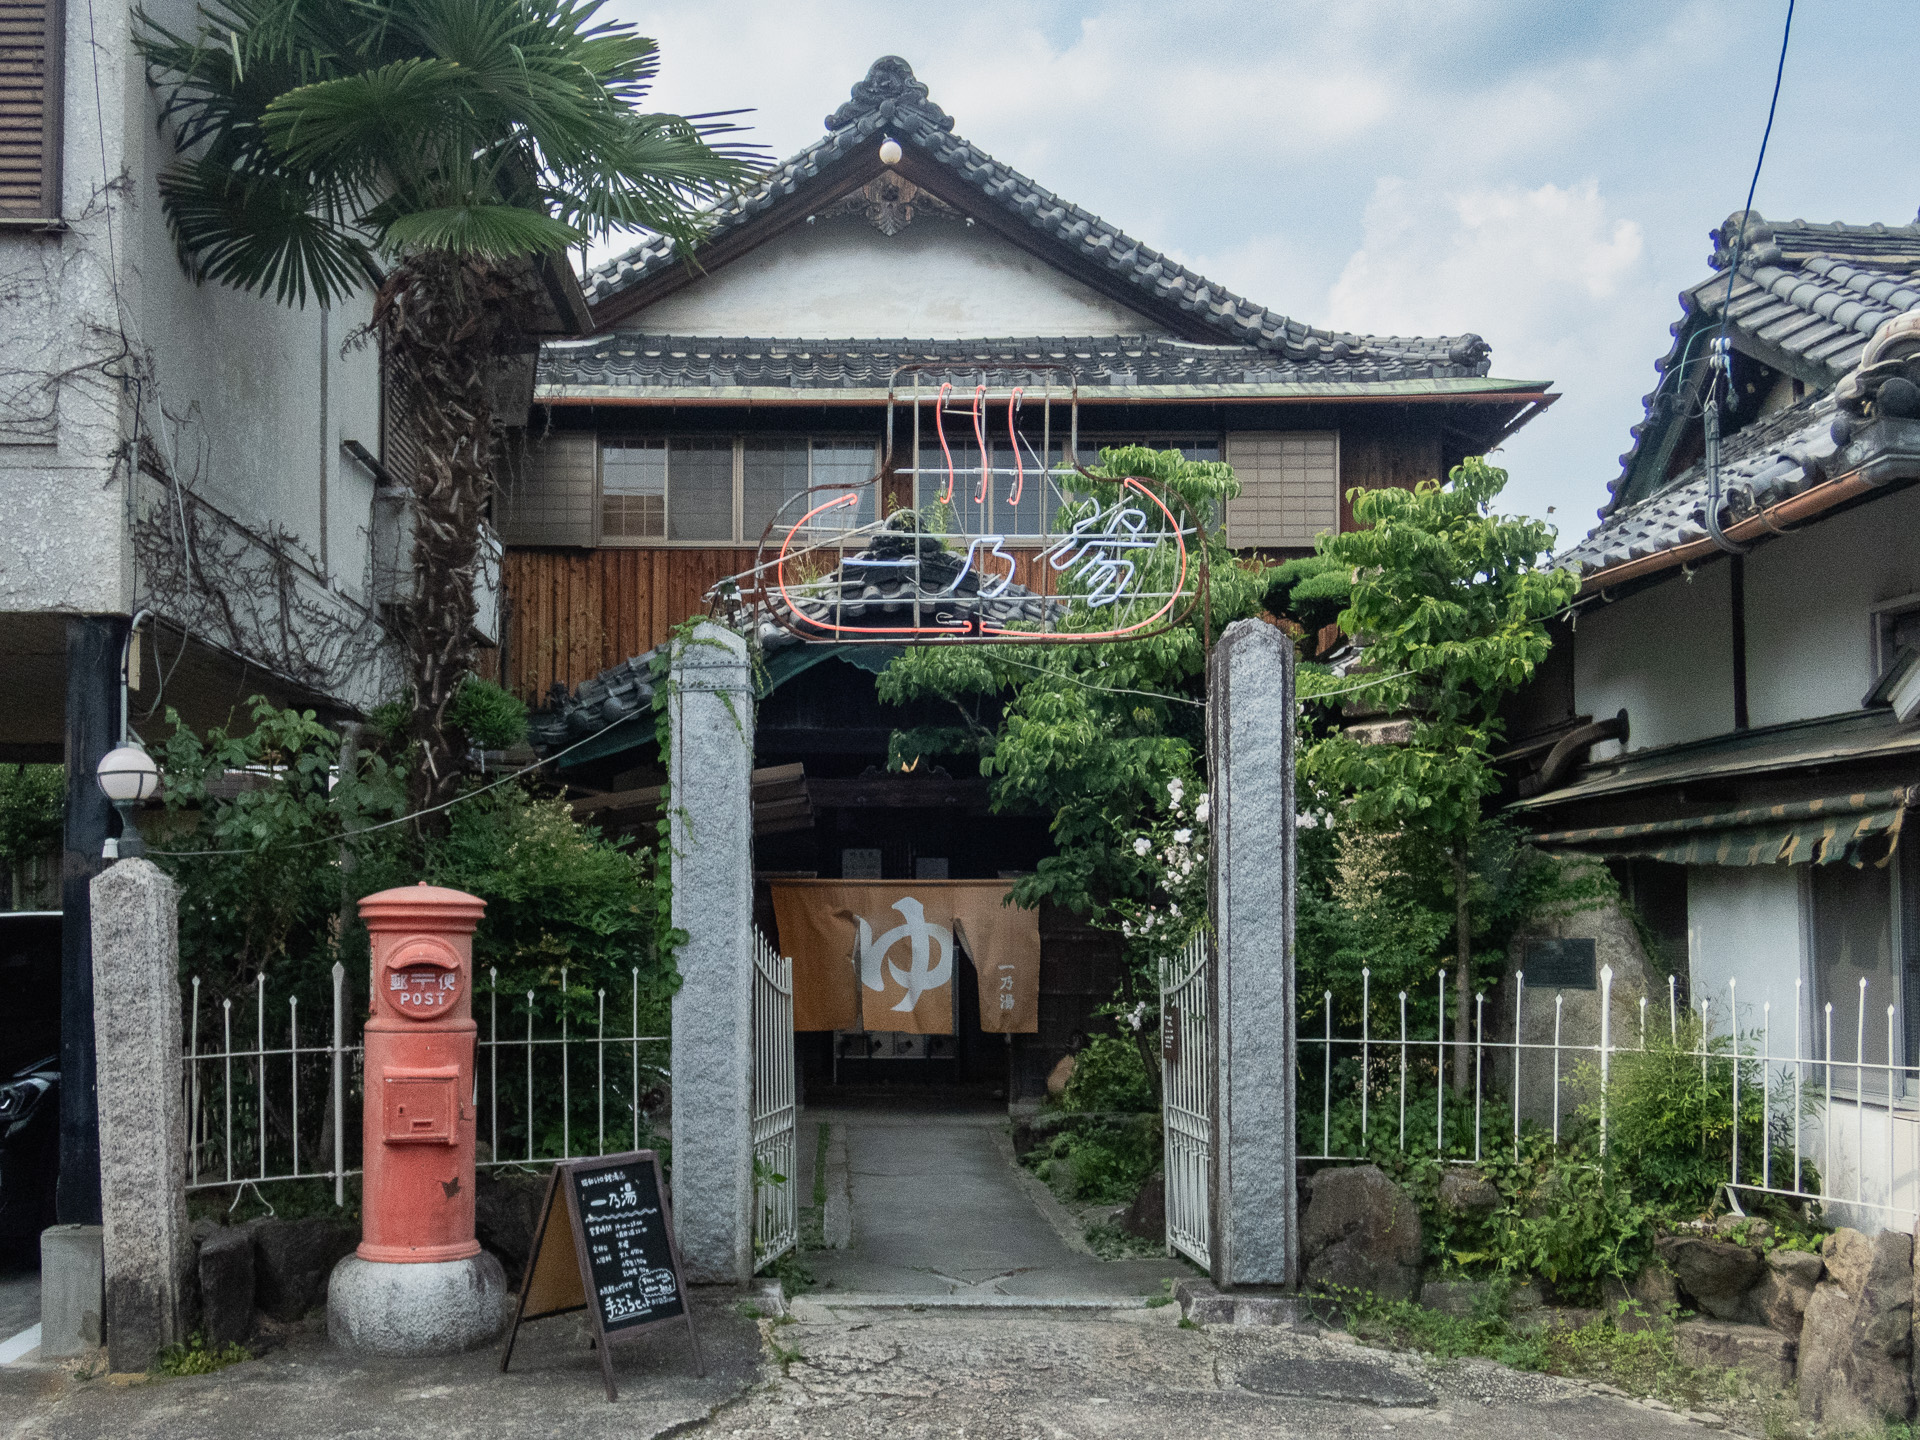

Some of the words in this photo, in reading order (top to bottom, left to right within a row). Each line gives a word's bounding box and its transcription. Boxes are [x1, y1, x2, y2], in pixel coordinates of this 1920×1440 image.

[840, 496, 1158, 608] 一乃湯
[855, 896, 954, 1012] ゆ
[400, 992, 446, 1006] POST
[997, 963, 1016, 1011] 一乃湯
[590, 1182, 637, 1209] 一乃湯
